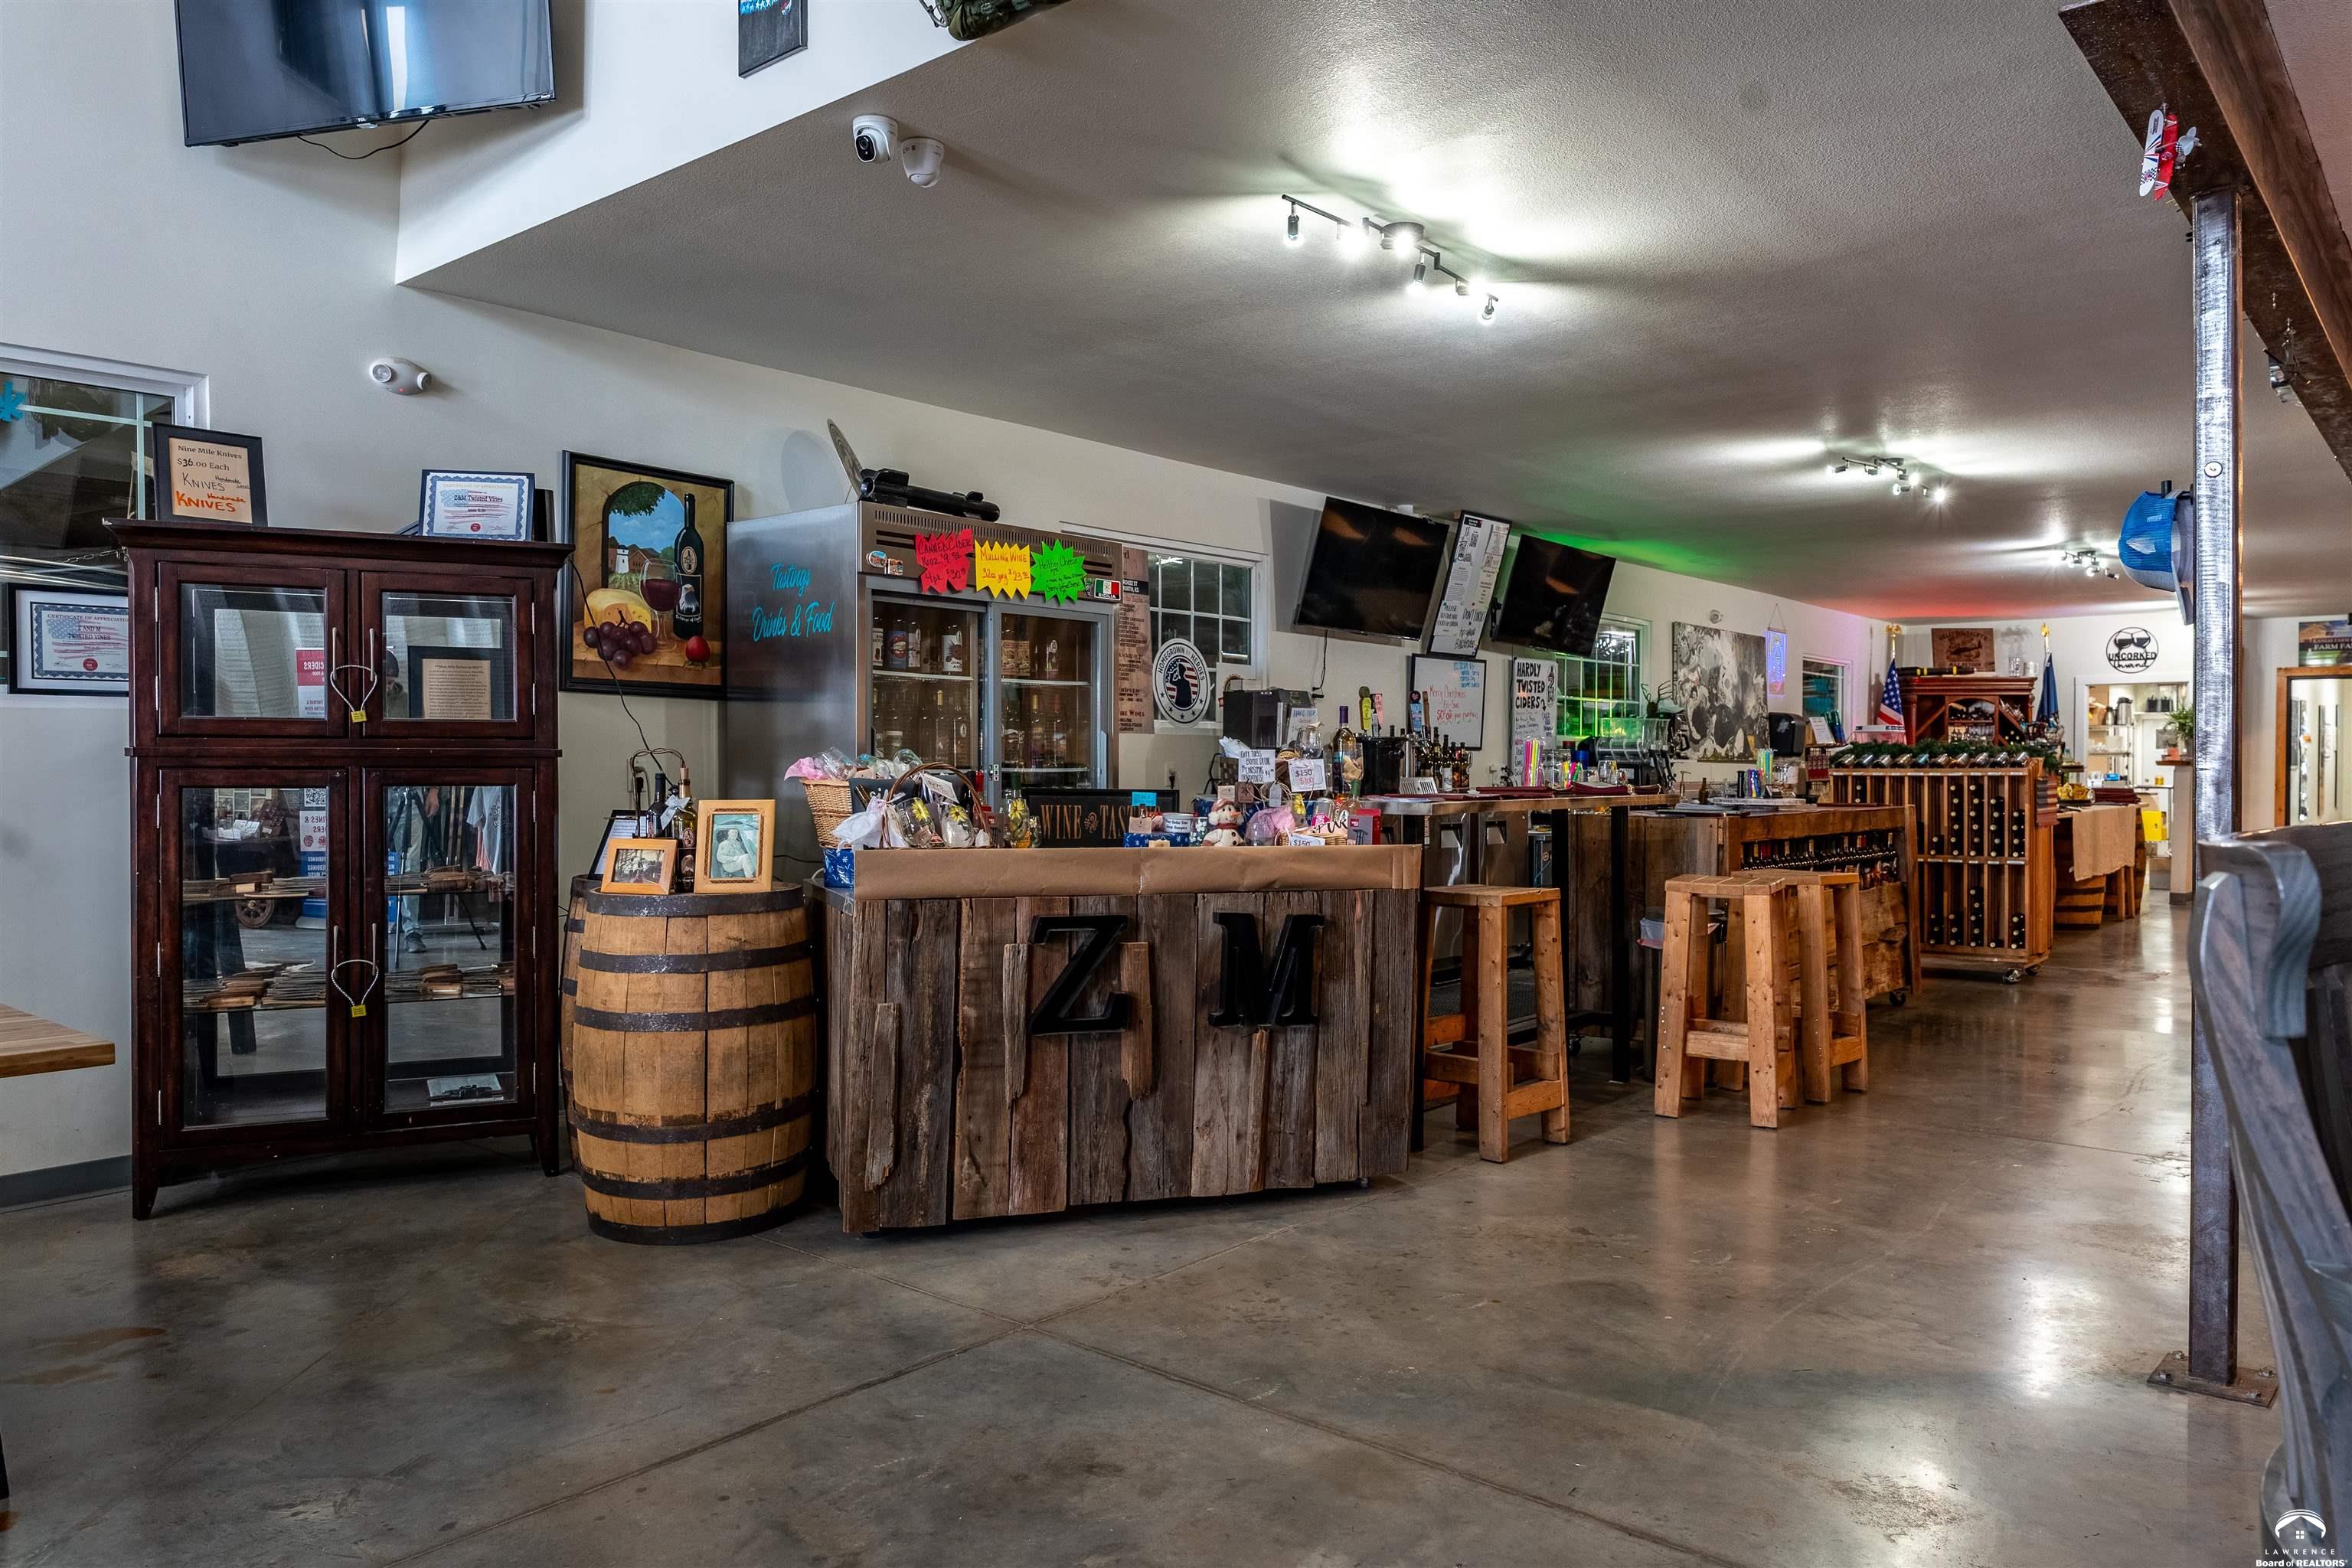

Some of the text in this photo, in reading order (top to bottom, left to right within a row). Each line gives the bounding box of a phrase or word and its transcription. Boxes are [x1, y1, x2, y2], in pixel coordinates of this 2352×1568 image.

[217, 451, 243, 459] Knives
[177, 458, 230, 471] $36.00 Each
[182, 472, 225, 492] KNIVES
[175, 490, 236, 513] KNIVES
[770, 563, 812, 597] Tastings
[753, 601, 835, 642] Drinks & Food
[1158, 645, 1185, 674] HOMEGROWN
[1191, 654, 1206, 681] HEROES
[2109, 652, 2157, 661] UNCORKED
[1517, 662, 1541, 678] HARDLY
[1516, 679, 1545, 694] TWISTED
[1515, 695, 1540, 709] CIDERS
[1295, 769, 1312, 778] $150
[1040, 805, 1082, 839] WINE
[1027, 912, 1325, 1036] Z M
